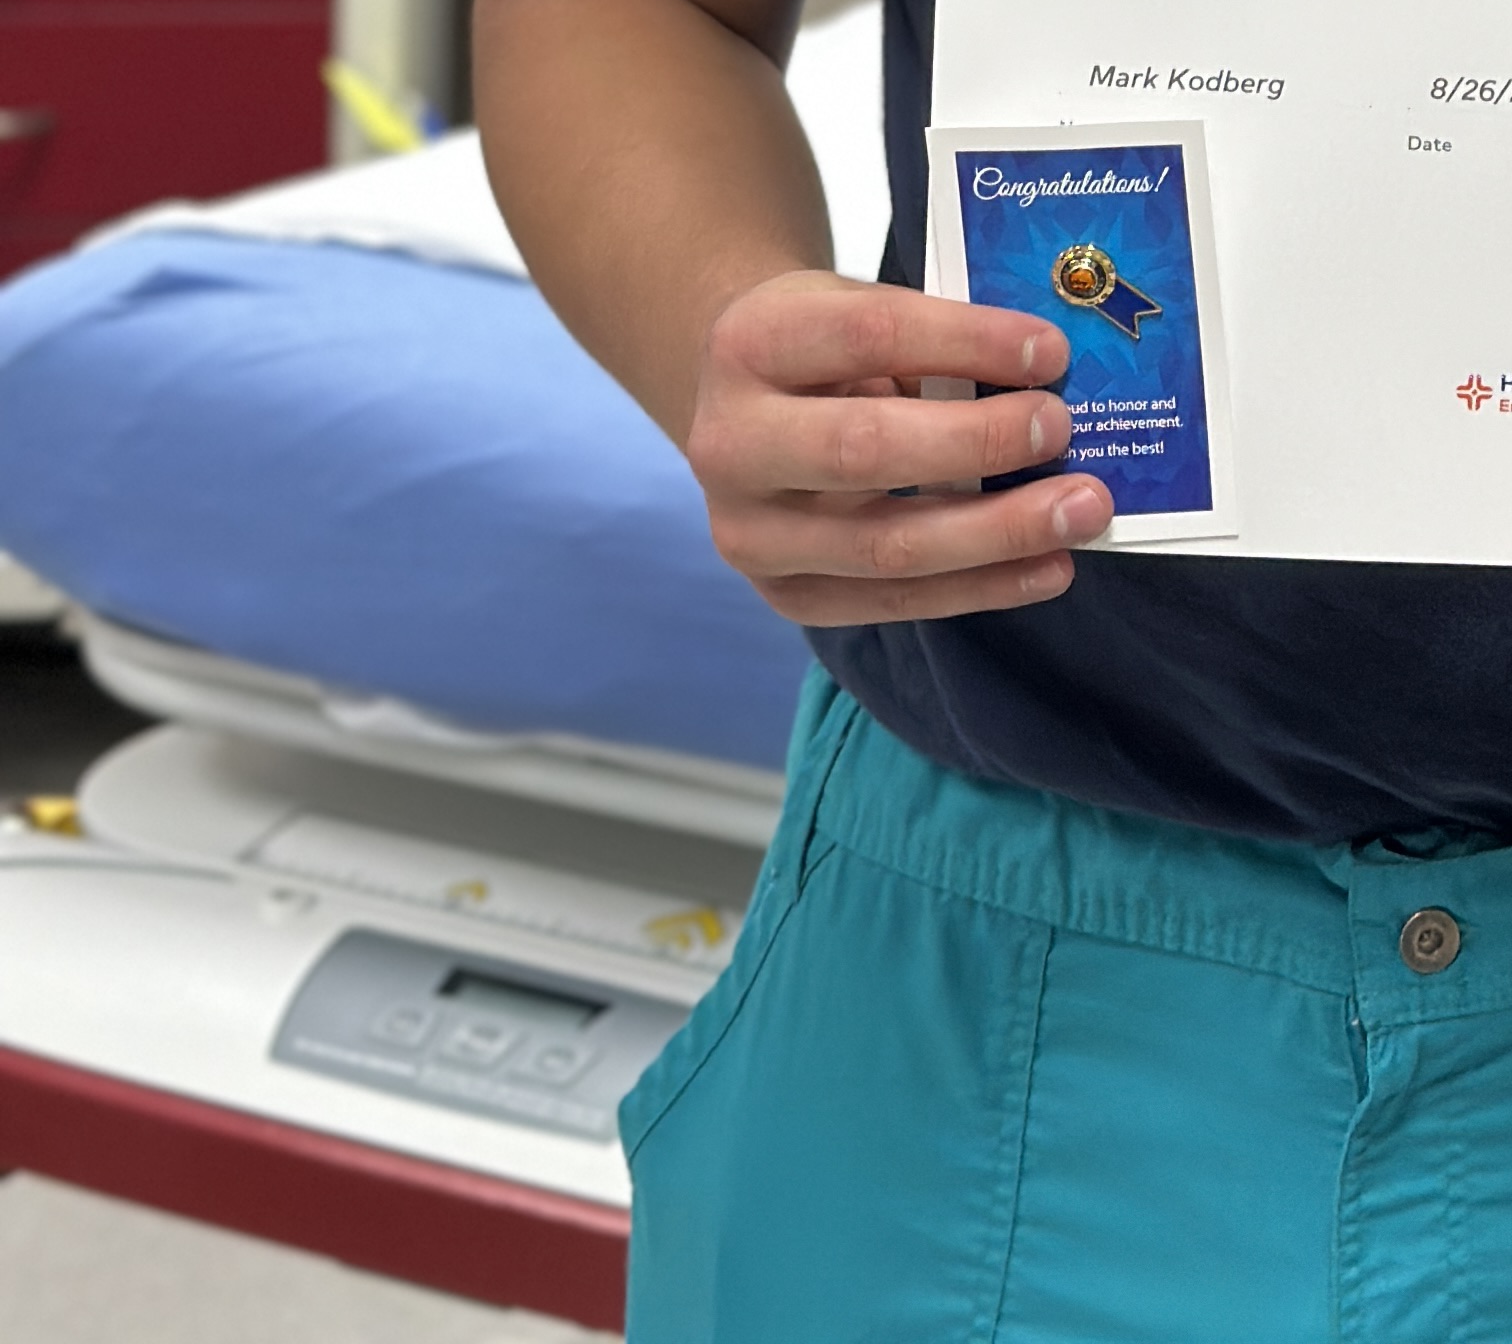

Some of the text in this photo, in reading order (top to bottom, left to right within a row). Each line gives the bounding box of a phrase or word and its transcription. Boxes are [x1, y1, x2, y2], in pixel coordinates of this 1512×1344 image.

[1088, 64, 1286, 101] Mark Kodberg
[1407, 134, 1453, 152] Date
[972, 165, 1171, 208] Congratulations!
[1091, 401, 1106, 413] to
[1108, 398, 1149, 412] honor
[1151, 395, 1177, 410] and
[1095, 414, 1184, 433] achievement.
[1079, 447, 1104, 462] you
[1107, 443, 1130, 457] the
[1131, 440, 1165, 456] best!
